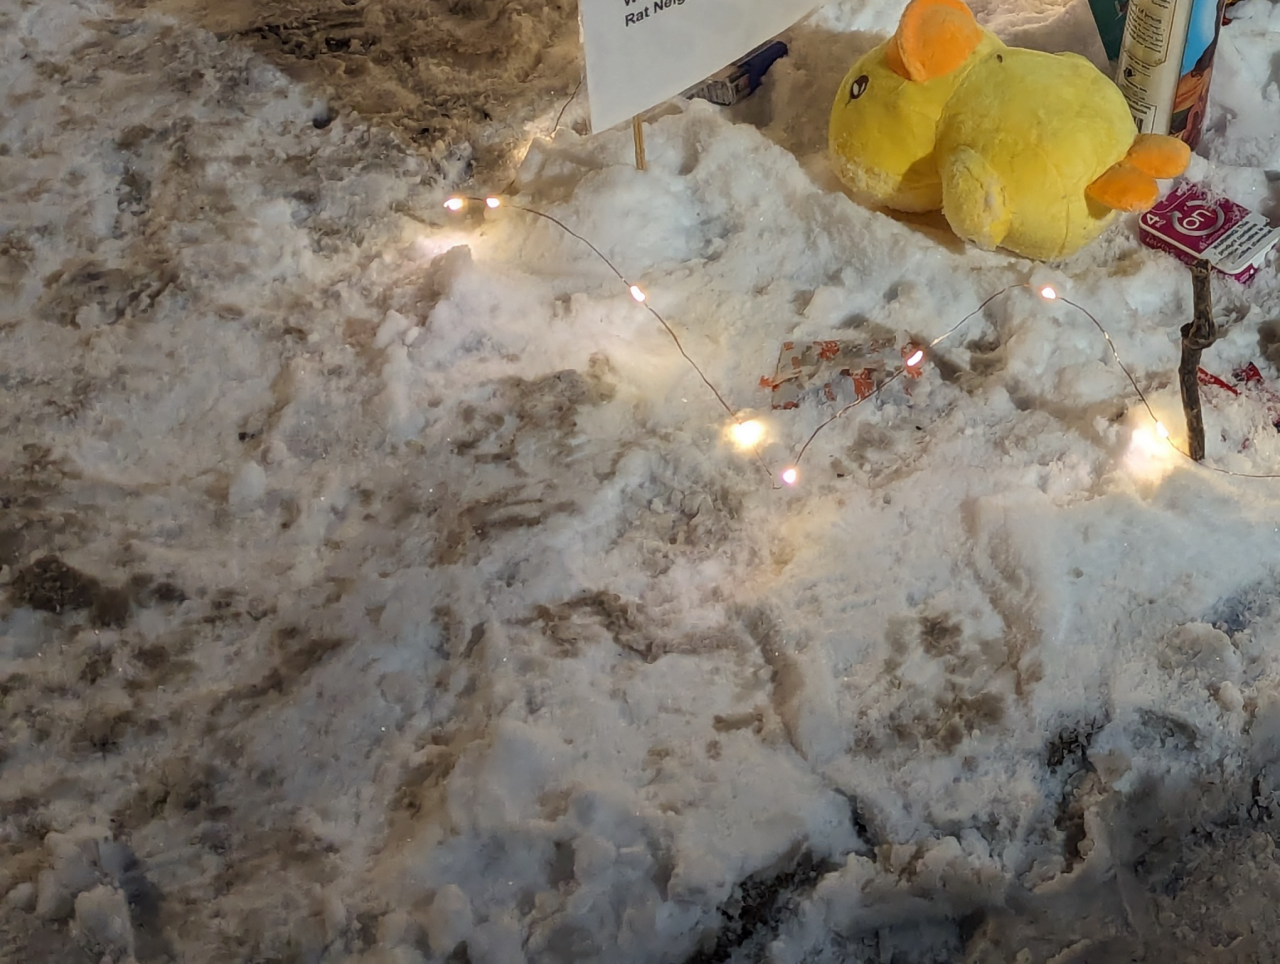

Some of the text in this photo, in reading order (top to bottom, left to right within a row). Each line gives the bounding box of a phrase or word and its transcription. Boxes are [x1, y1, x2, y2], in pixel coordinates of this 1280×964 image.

[624, 6, 650, 27] Rat
[1146, 213, 1160, 226] 4
[1183, 208, 1215, 230] on
